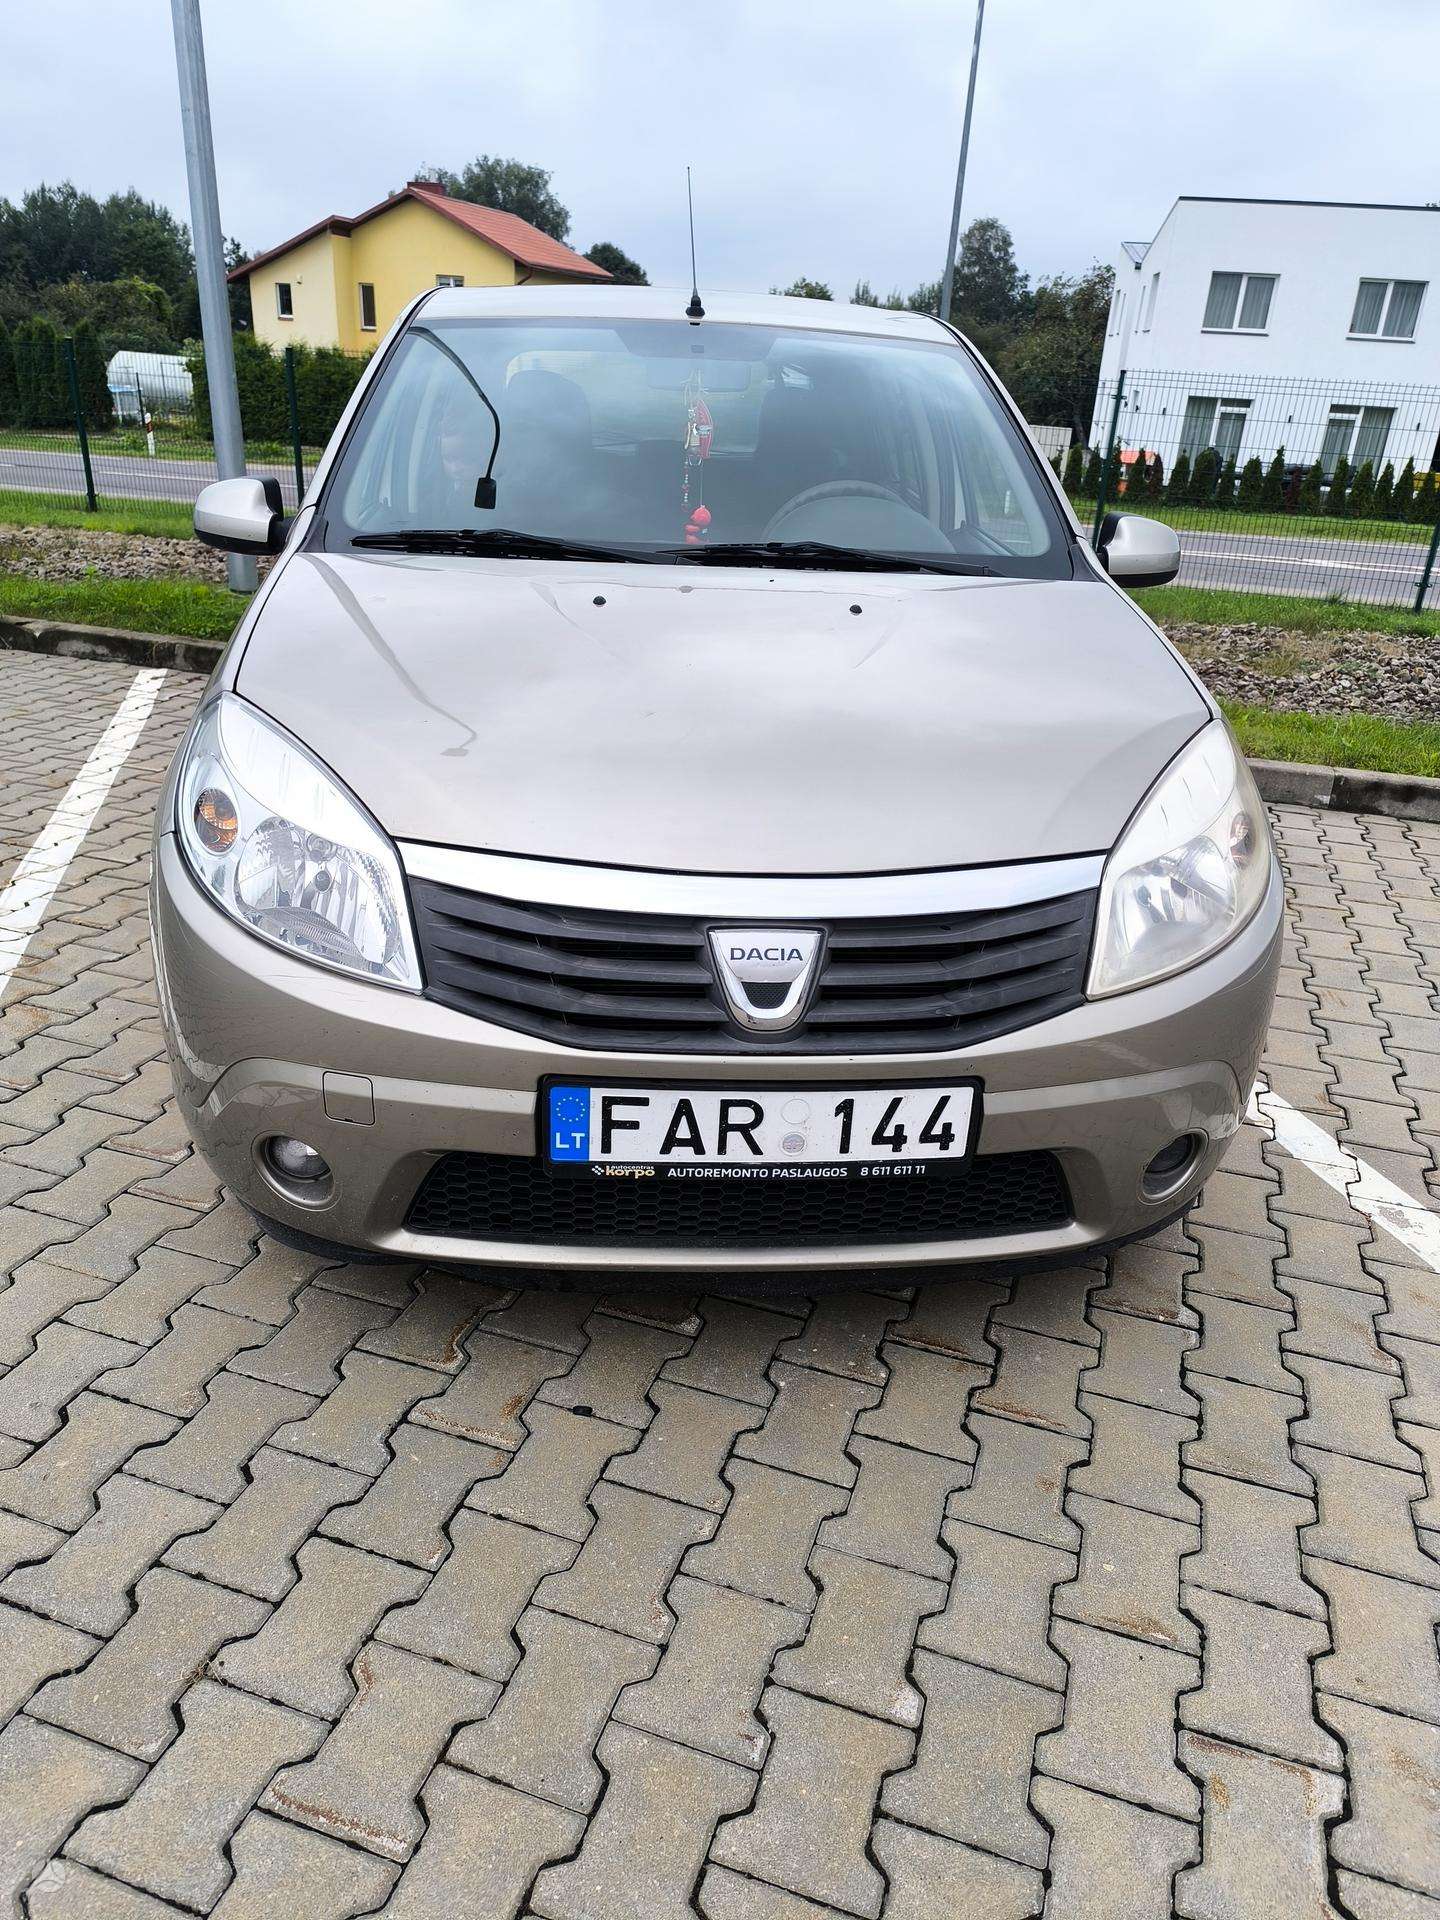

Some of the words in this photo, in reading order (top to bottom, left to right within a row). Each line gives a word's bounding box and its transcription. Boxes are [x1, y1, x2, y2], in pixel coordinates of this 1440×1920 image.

[730, 947, 804, 961] DACIA
[600, 1095, 765, 1156] FAR
[833, 1095, 956, 1155] 144
[555, 1132, 586, 1149] LT
[605, 1165, 656, 1179] korpo
[667, 1168, 769, 1178] AUTOREMONTO
[772, 1167, 848, 1178] PASLAUGOS
[860, 1166, 869, 1176] 8
[872, 1166, 890, 1176] 611
[893, 1165, 912, 1175] 611
[915, 1165, 926, 1175] 11
